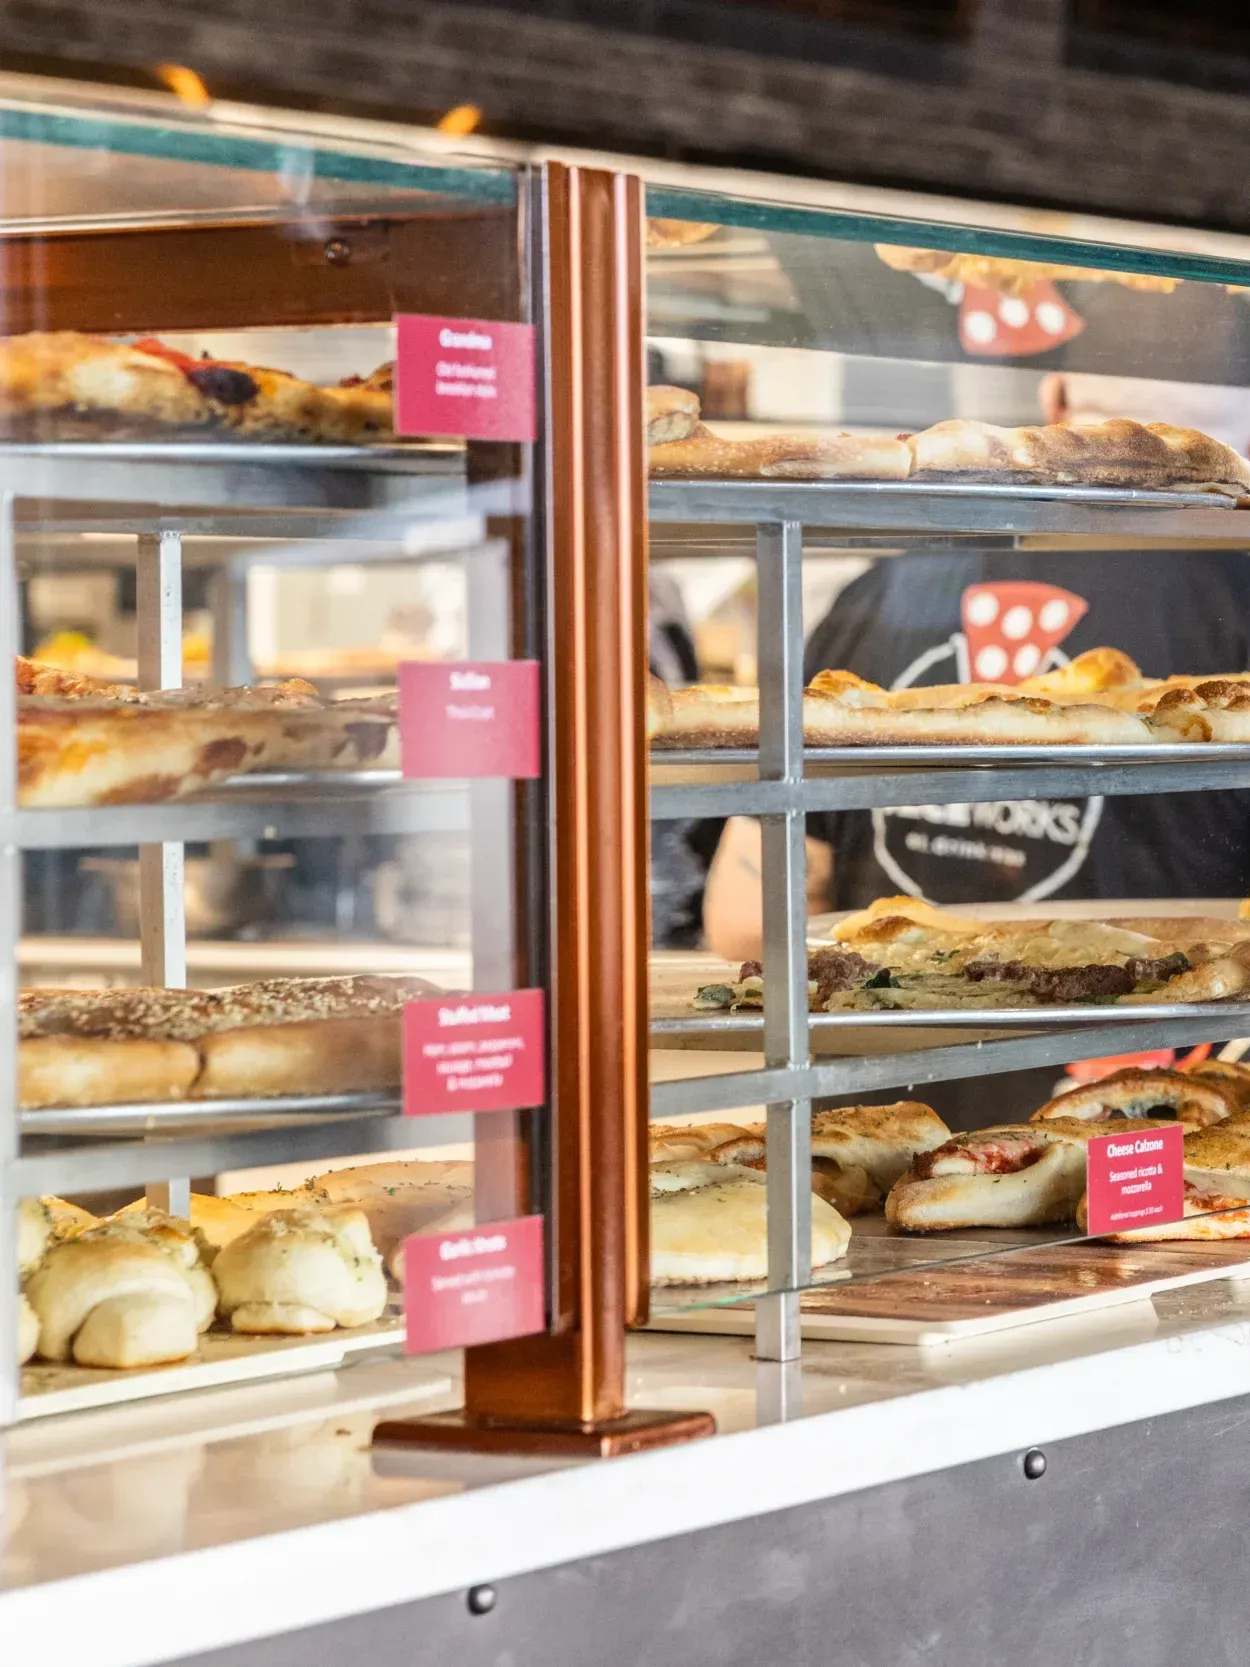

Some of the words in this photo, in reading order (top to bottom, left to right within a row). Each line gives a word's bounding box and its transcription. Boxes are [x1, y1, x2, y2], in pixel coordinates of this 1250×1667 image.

[1107, 1143, 1134, 1158] Cheese
[1134, 1139, 1164, 1153] Calzone
[1109, 1168, 1138, 1182] Seasoned
[1138, 1166, 1157, 1177] ricotta
[1157, 1163, 1163, 1174] &
[1121, 1180, 1152, 1195] mozzarella
